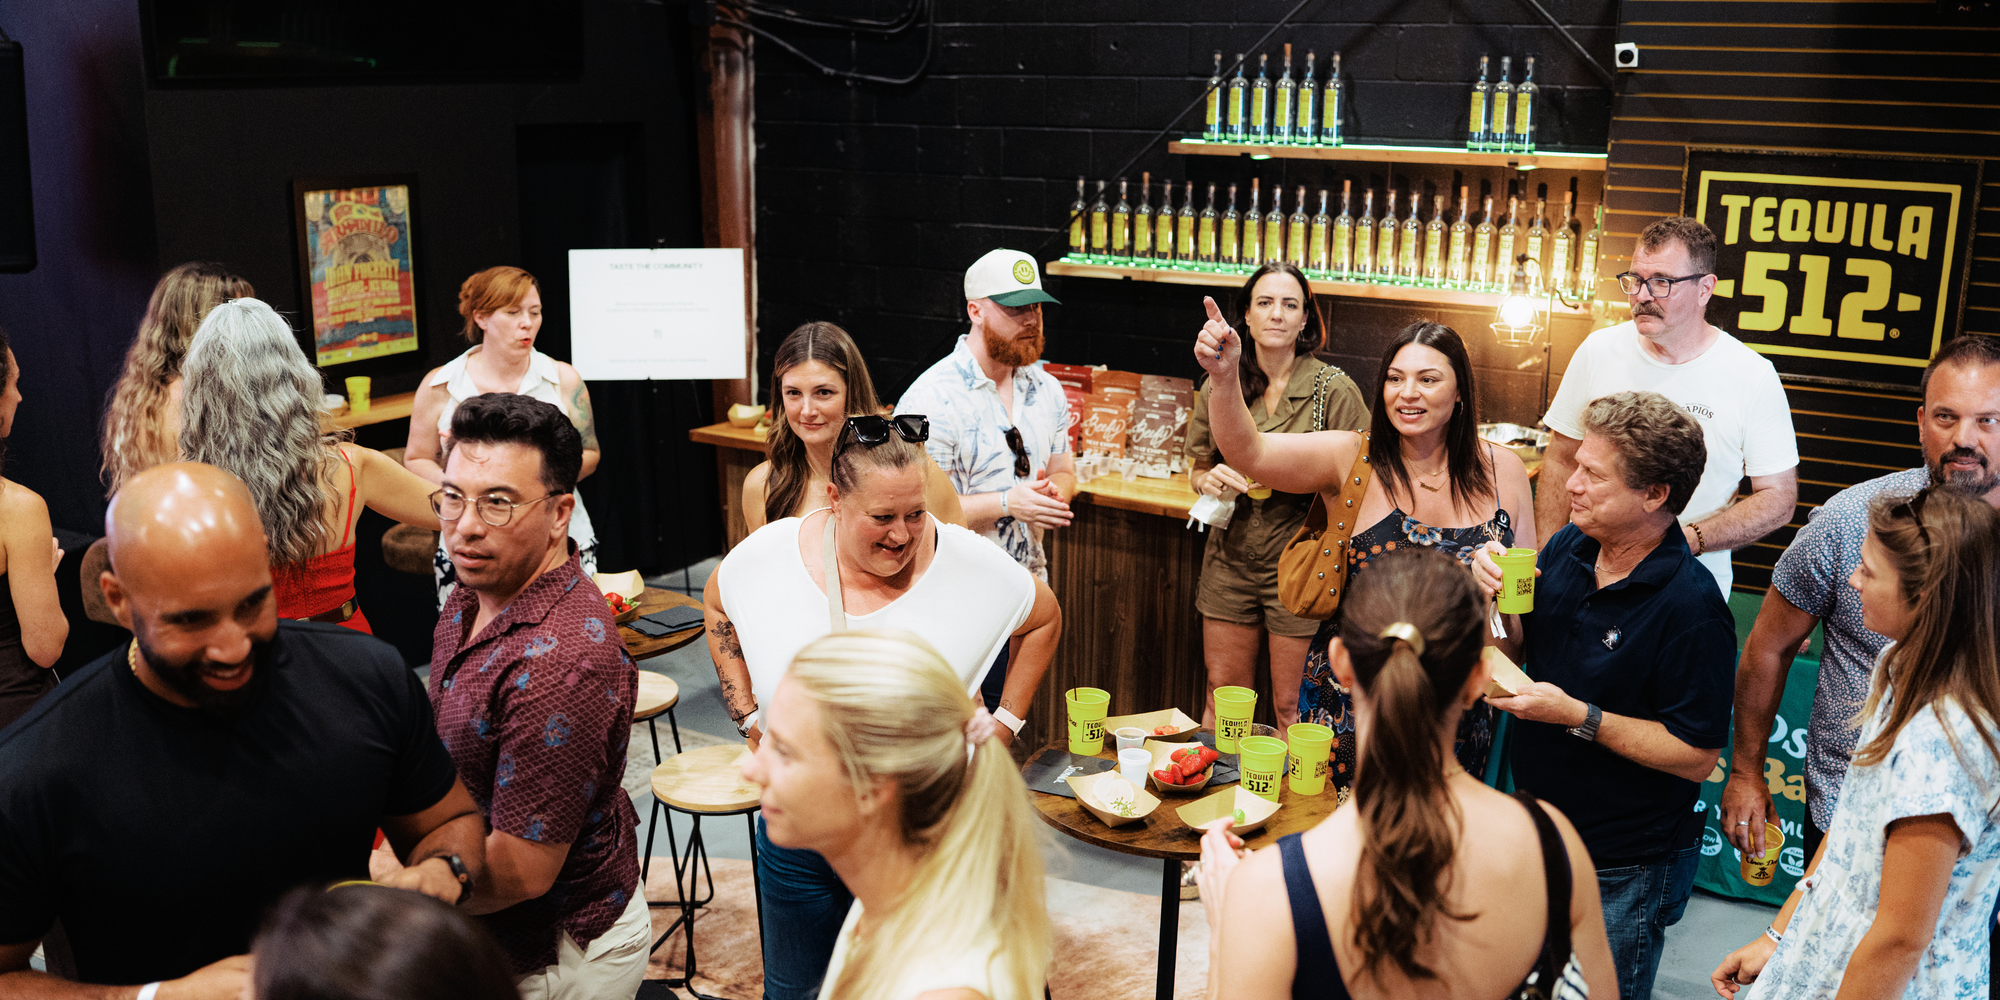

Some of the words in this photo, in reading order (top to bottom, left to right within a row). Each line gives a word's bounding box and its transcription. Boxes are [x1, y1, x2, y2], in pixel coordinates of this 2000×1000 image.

[1720, 194, 1934, 261] TEQUILA
[1684, 405, 1715, 419] APIOS
[1222, 719, 1248, 727] TEQUILA
[1246, 771, 1274, 781] TEQUILA
[1703, 834, 1716, 843] OW
